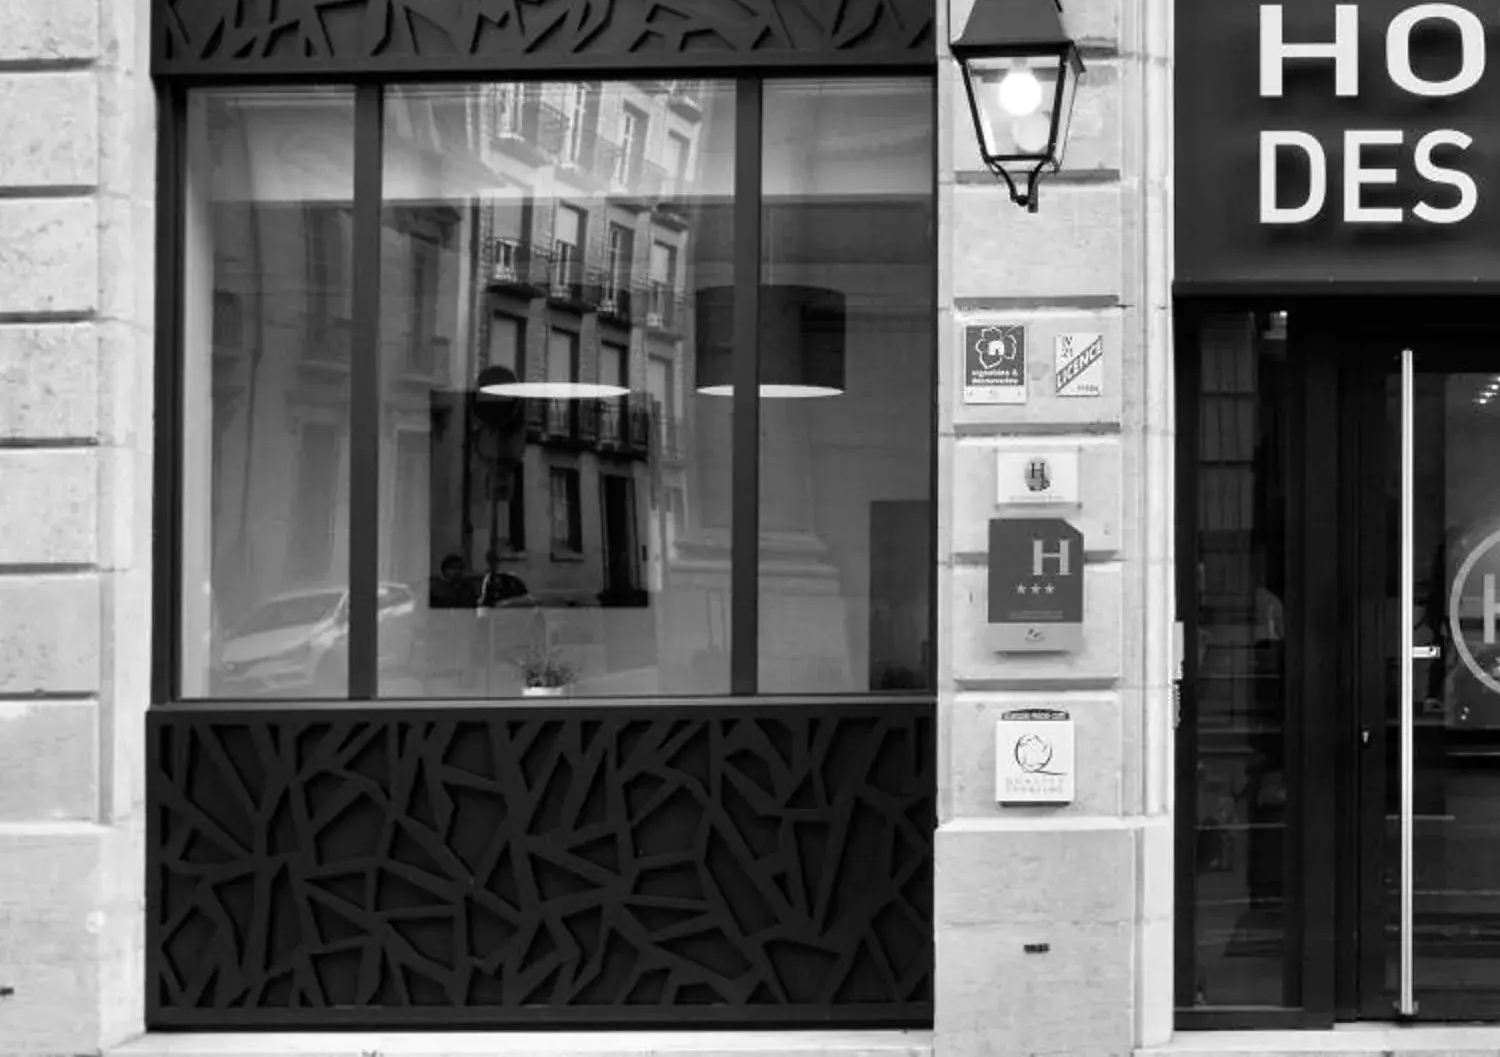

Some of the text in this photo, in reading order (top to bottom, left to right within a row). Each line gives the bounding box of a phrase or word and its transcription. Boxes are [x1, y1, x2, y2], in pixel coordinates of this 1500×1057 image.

[1260, 129, 1478, 224] DES
[1056, 340, 1103, 389] LICENCE
[1033, 539, 1070, 576] H
